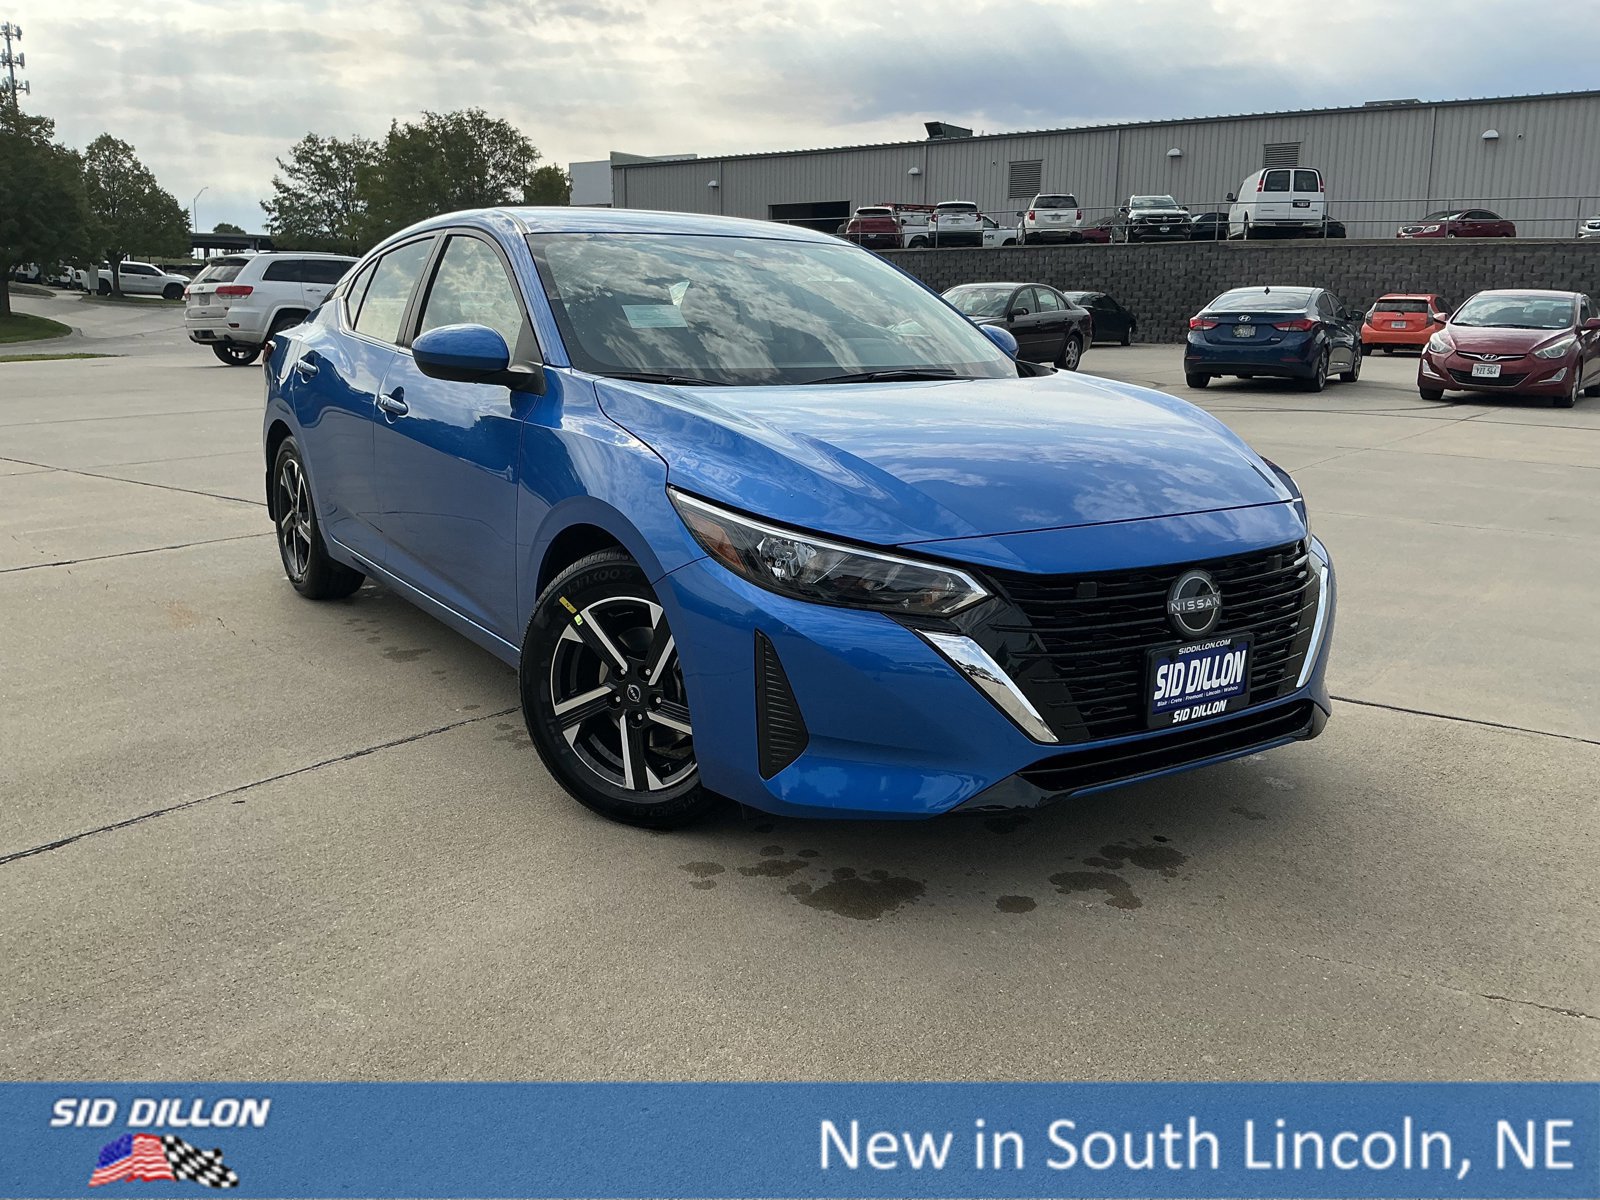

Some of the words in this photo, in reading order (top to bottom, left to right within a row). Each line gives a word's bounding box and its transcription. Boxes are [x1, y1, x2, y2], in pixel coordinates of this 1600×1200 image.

[1171, 597, 1220, 612] NISSAN
[1178, 638, 1231, 655] SIDDILLON.COM
[1154, 662, 1186, 700] SID
[1186, 650, 1247, 694] DILLON
[1205, 689, 1221, 697] Lincoln
[1172, 709, 1190, 724] SID
[1191, 699, 1228, 719] DILLON
